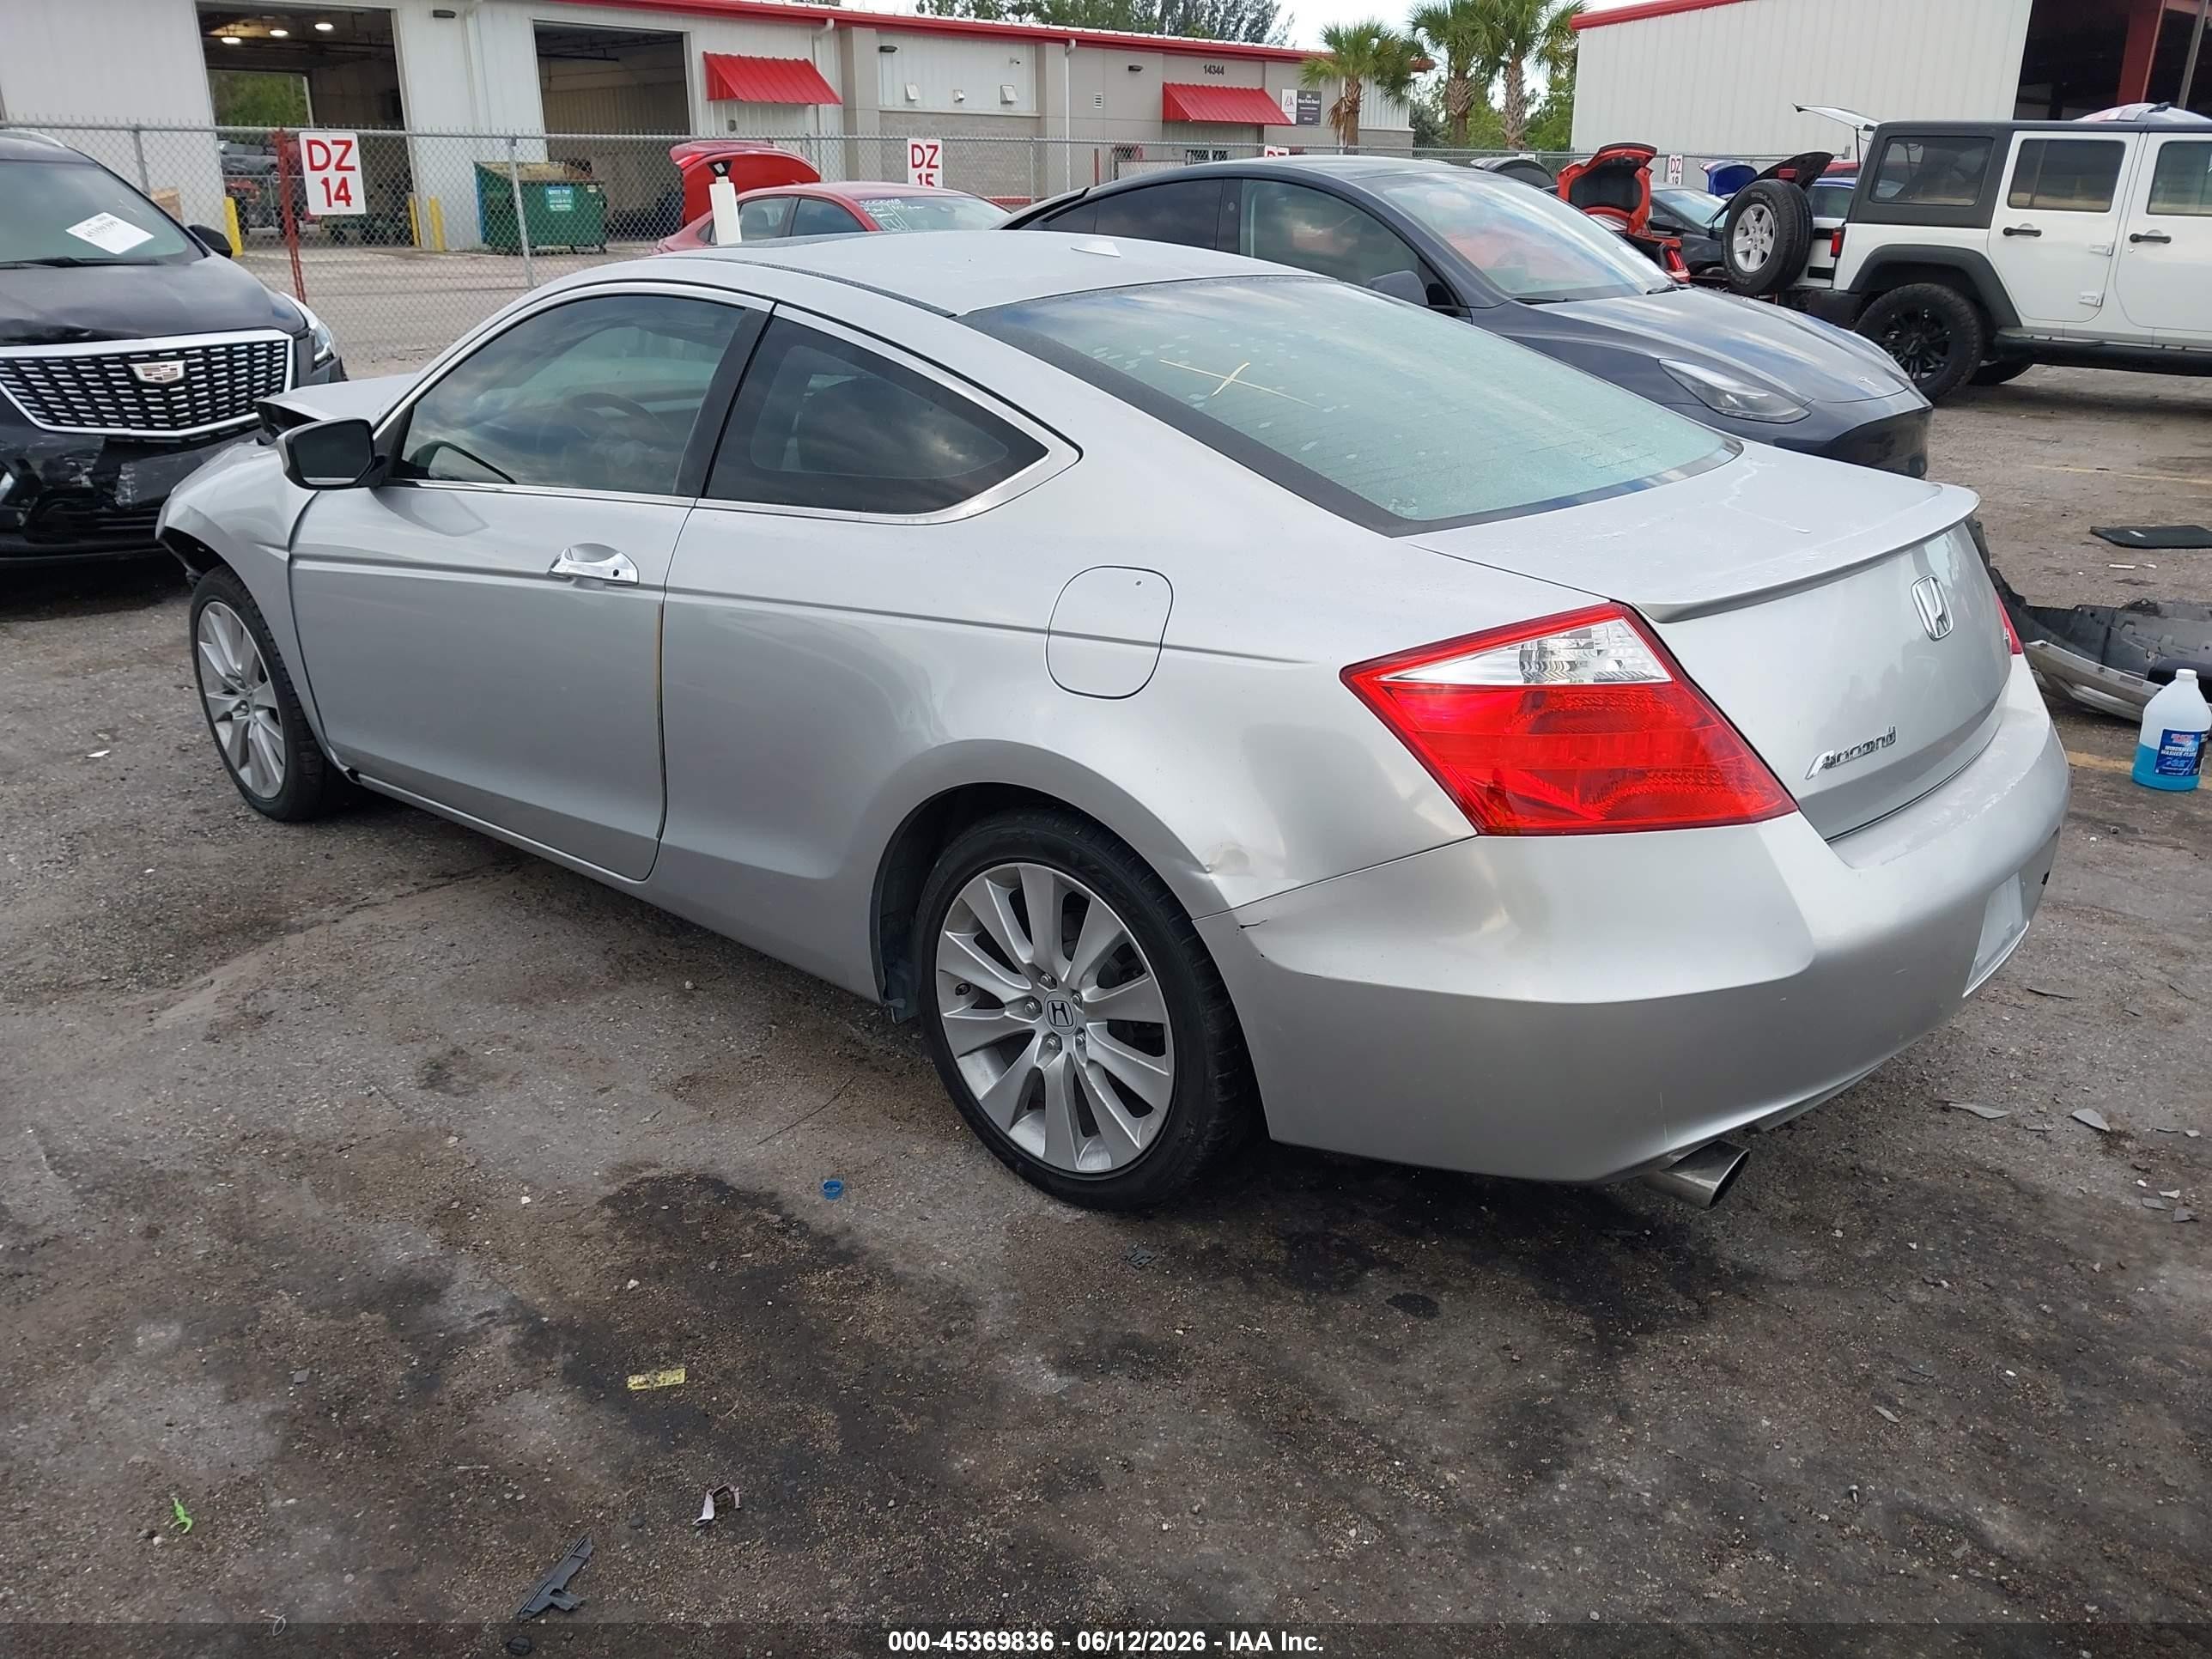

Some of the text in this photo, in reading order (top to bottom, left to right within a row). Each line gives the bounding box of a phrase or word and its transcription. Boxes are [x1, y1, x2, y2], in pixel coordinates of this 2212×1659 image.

[1203, 64, 1224, 76] 14344
[306, 139, 356, 171] DZ
[911, 143, 939, 169] DZ
[1670, 158, 1681, 173] DZ
[320, 177, 352, 207] 14
[1805, 726, 1896, 781] Accord
